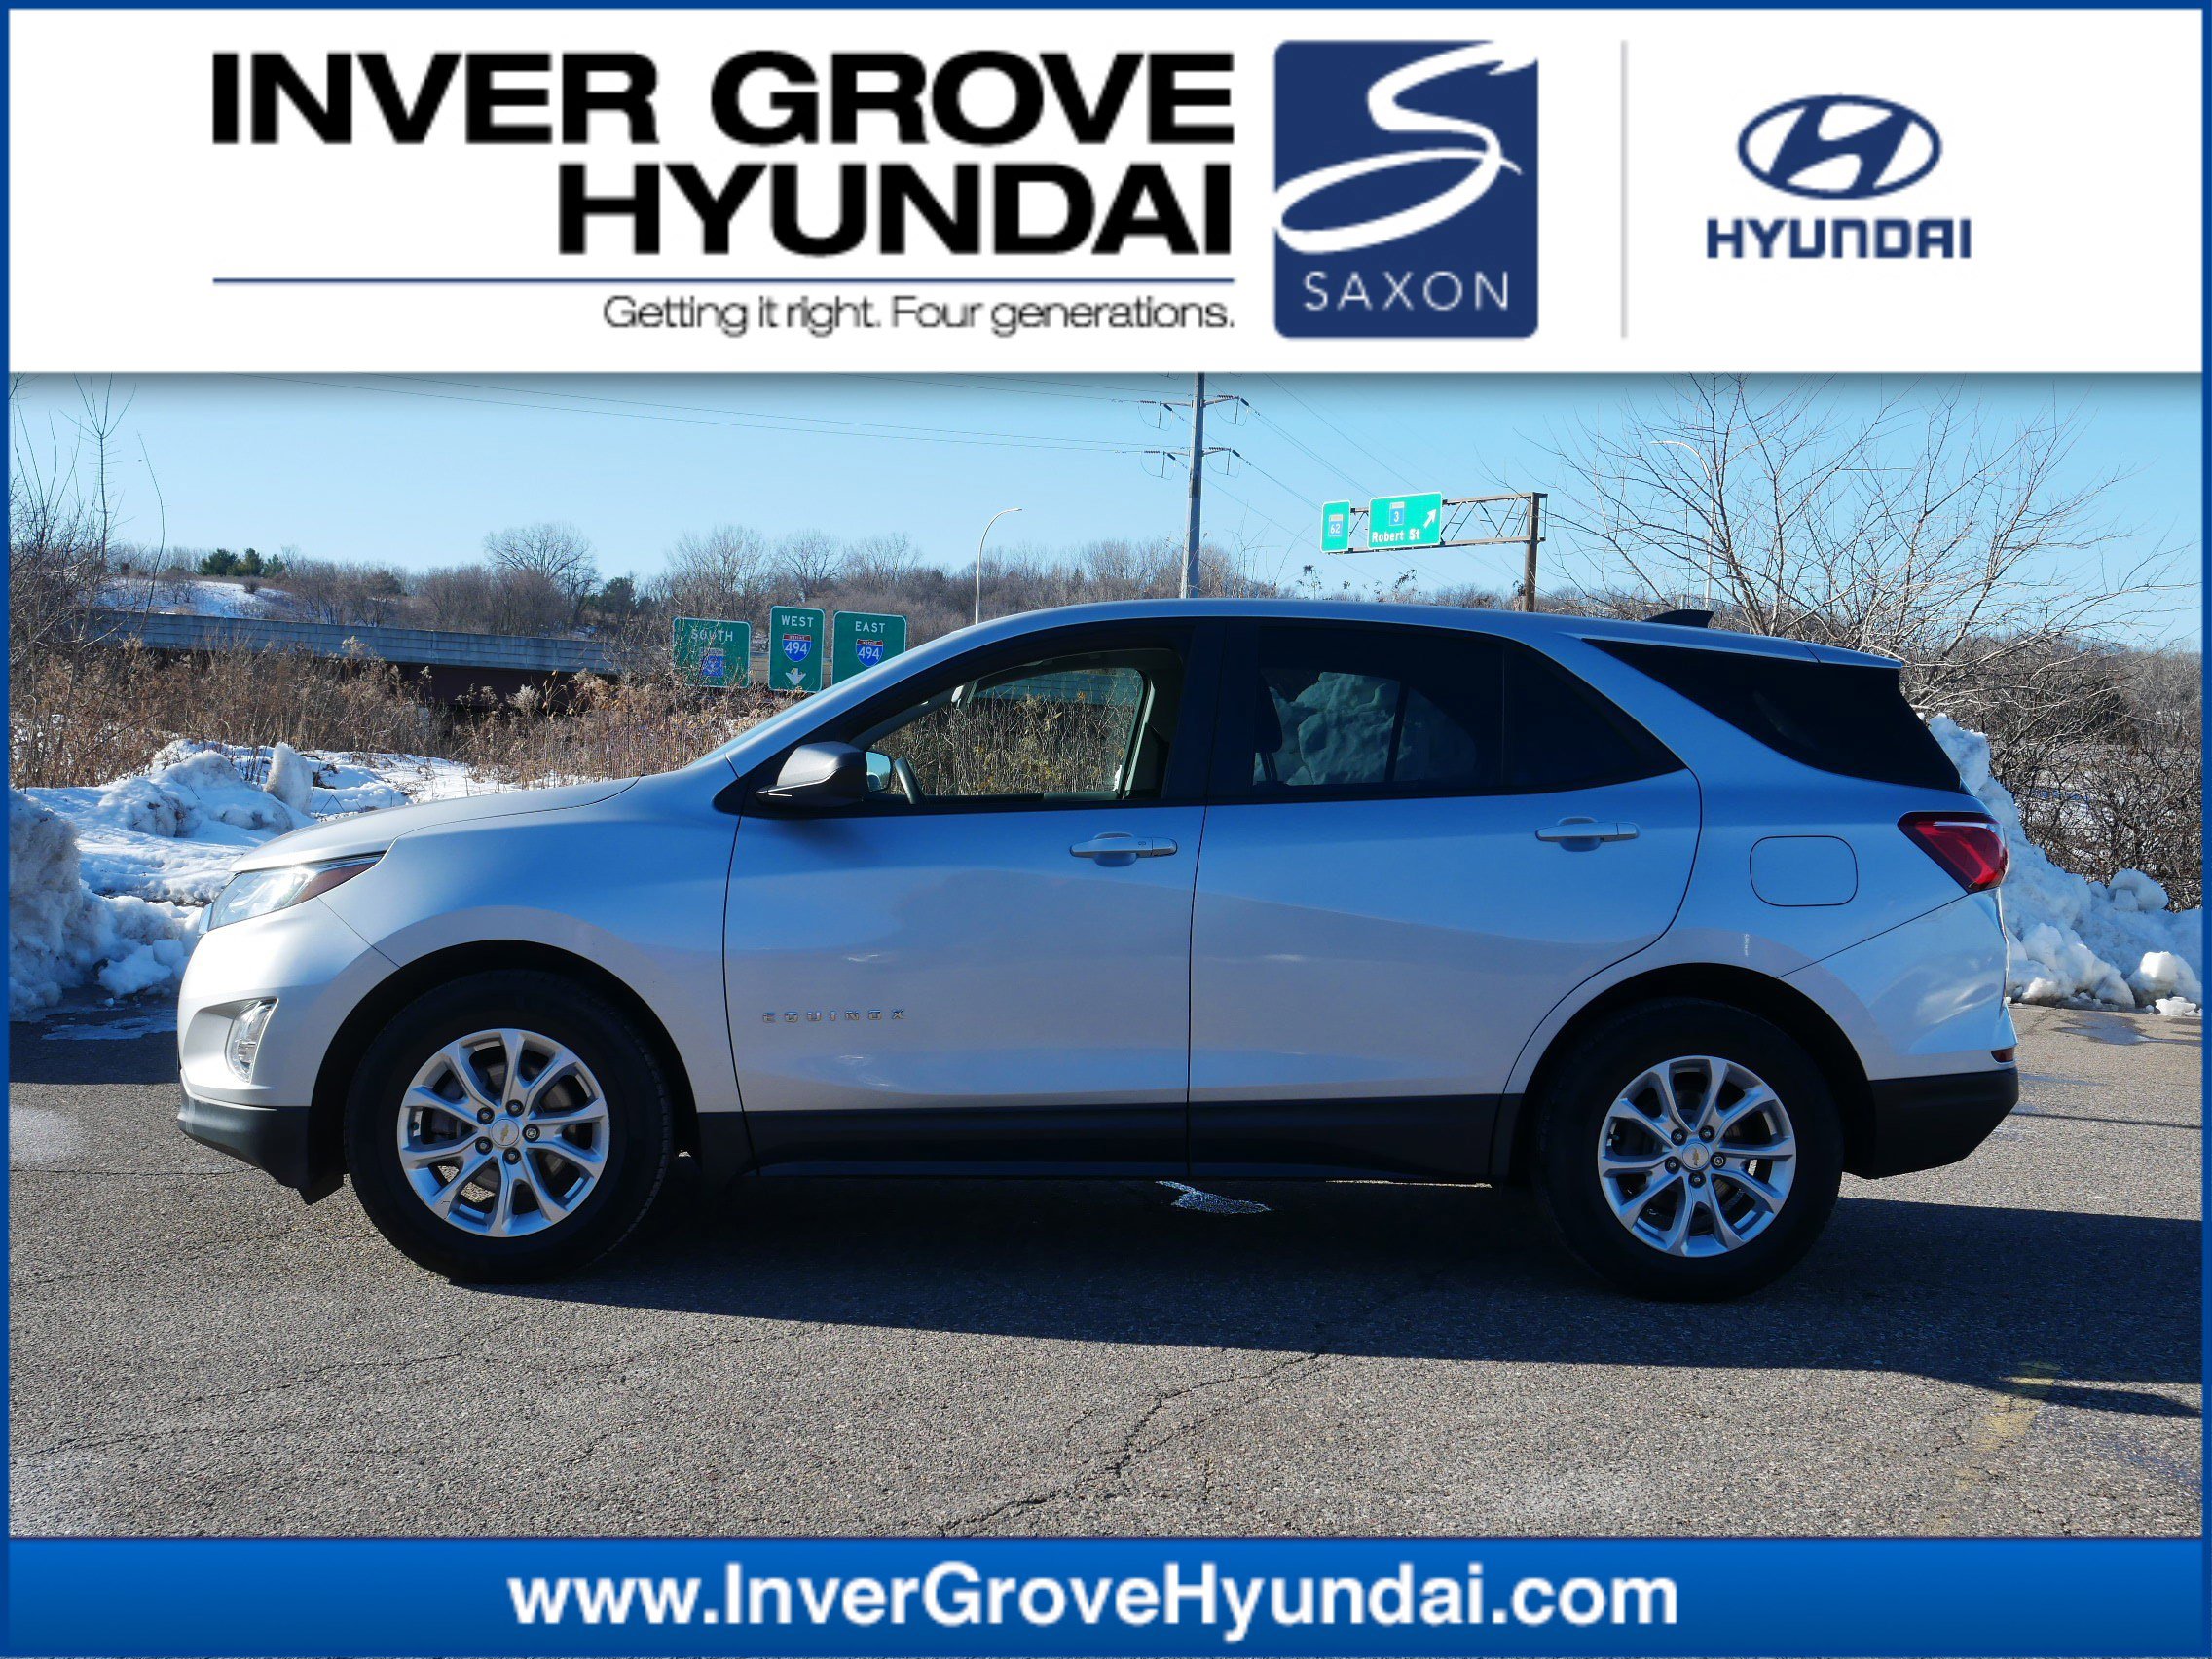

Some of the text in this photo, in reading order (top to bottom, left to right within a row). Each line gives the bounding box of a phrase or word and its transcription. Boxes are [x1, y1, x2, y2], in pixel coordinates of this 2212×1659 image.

[1393, 511, 1400, 523] 3
[1372, 528, 1420, 543] Robert St
[781, 614, 814, 628] WEST
[855, 620, 886, 634] EAST
[690, 629, 733, 642] SOUTH
[785, 641, 808, 655] 494
[857, 646, 880, 660] 494
[762, 1009, 904, 1022] EQUINOX
